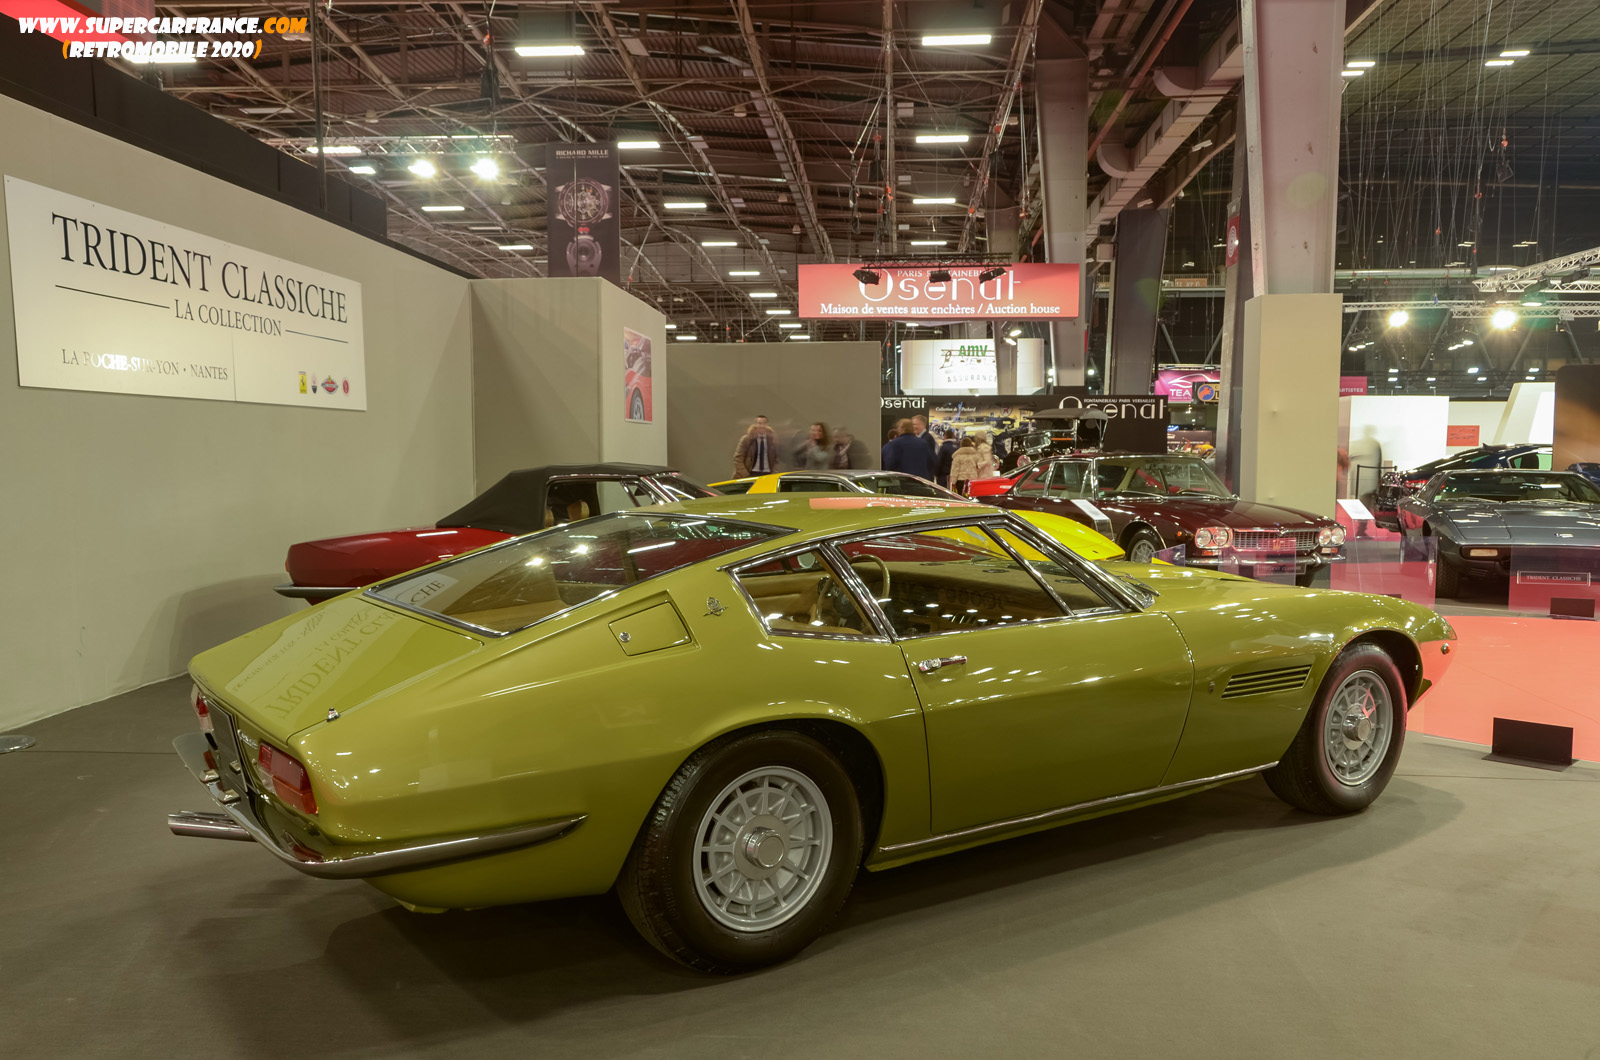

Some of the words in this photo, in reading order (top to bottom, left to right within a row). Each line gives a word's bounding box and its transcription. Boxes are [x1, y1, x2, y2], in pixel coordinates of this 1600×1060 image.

[52, 212, 211, 292] TRIDENT
[221, 261, 348, 324] CLASSICHE
[897, 270, 923, 278] PARIS
[174, 299, 195, 322] LA
[198, 304, 283, 337] COLLECTION
[820, 303, 859, 315] Maison
[861, 303, 875, 315] de
[876, 304, 908, 315] ventes
[911, 306, 929, 315] aux
[931, 303, 975, 315] enchères
[985, 303, 1028, 315] Auction
[1030, 303, 1061, 315] house
[61, 349, 81, 366] LA
[190, 364, 229, 381] NANTES
